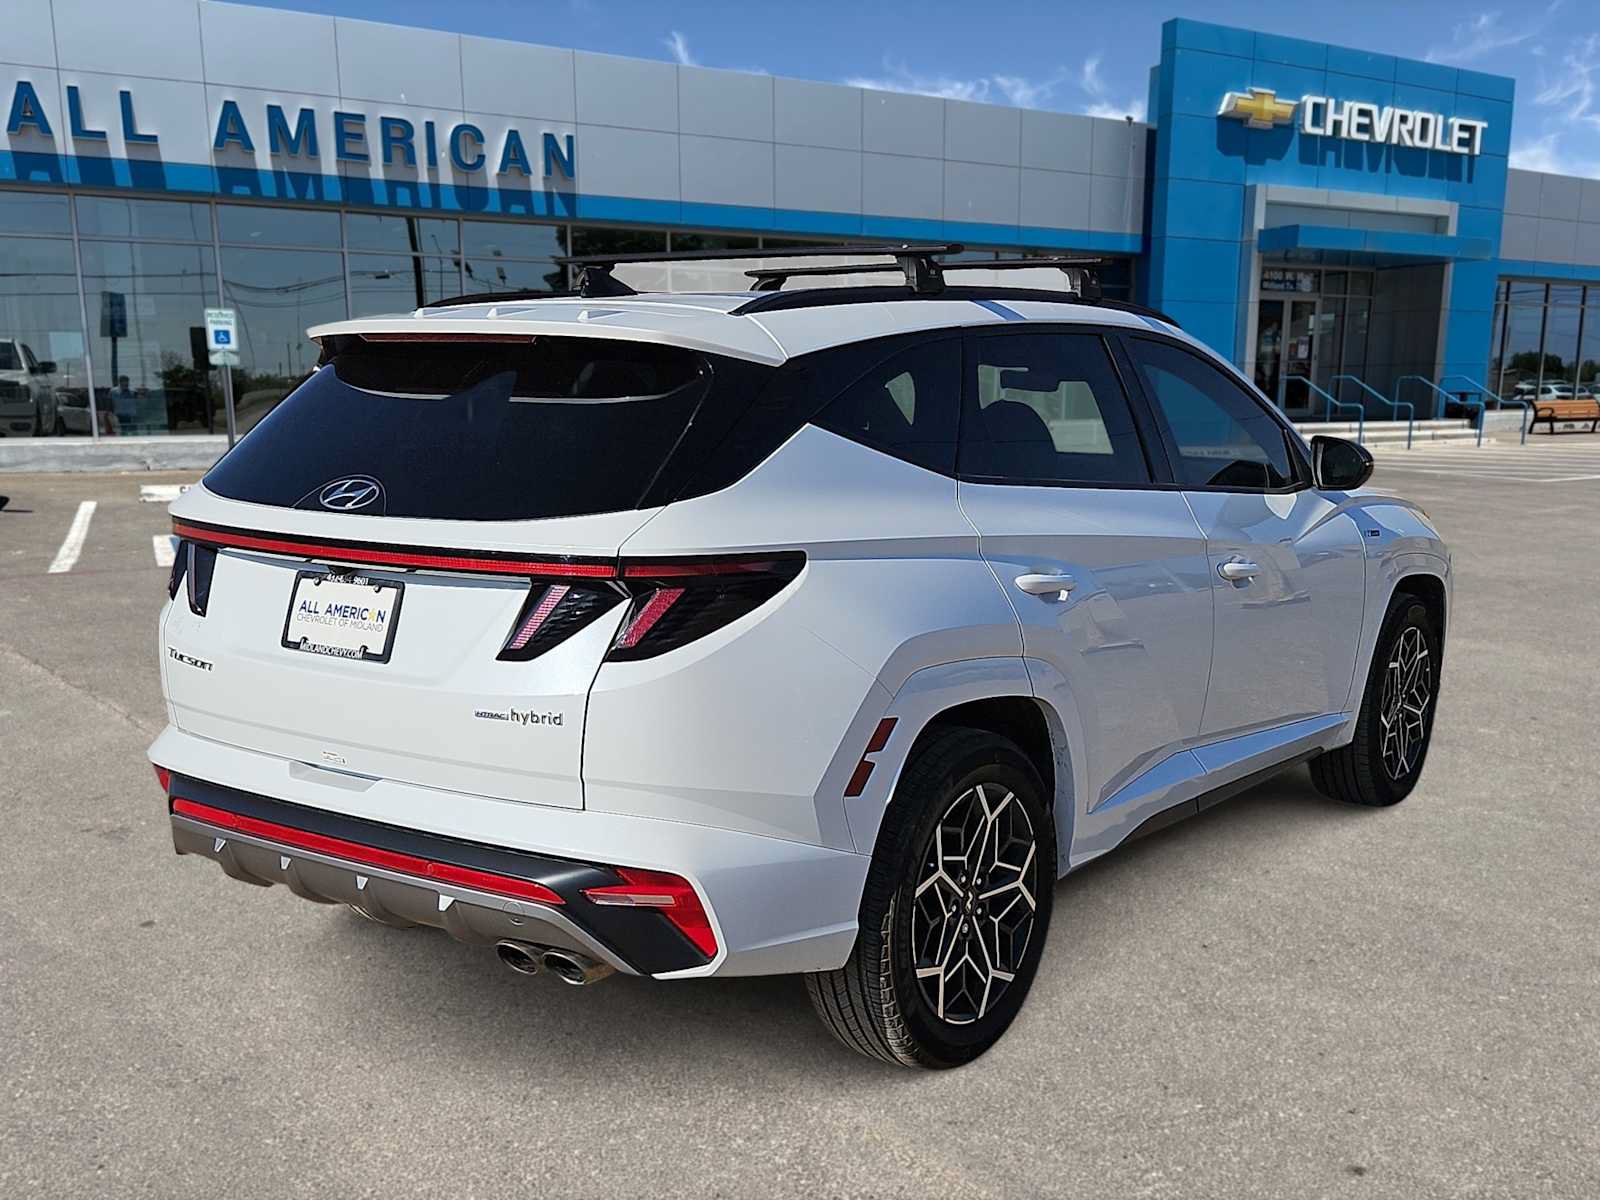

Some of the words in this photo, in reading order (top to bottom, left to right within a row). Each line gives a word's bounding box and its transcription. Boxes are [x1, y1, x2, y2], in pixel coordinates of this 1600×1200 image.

[6, 81, 158, 143] ALL
[213, 100, 576, 180] AMERICAN
[1301, 95, 1488, 155] CHEVROLET
[299, 600, 319, 614] ALL
[296, 614, 338, 626] CHEVROLET
[339, 618, 348, 628] OF
[349, 621, 384, 632] MIDLAND
[510, 708, 563, 726] hybrid
